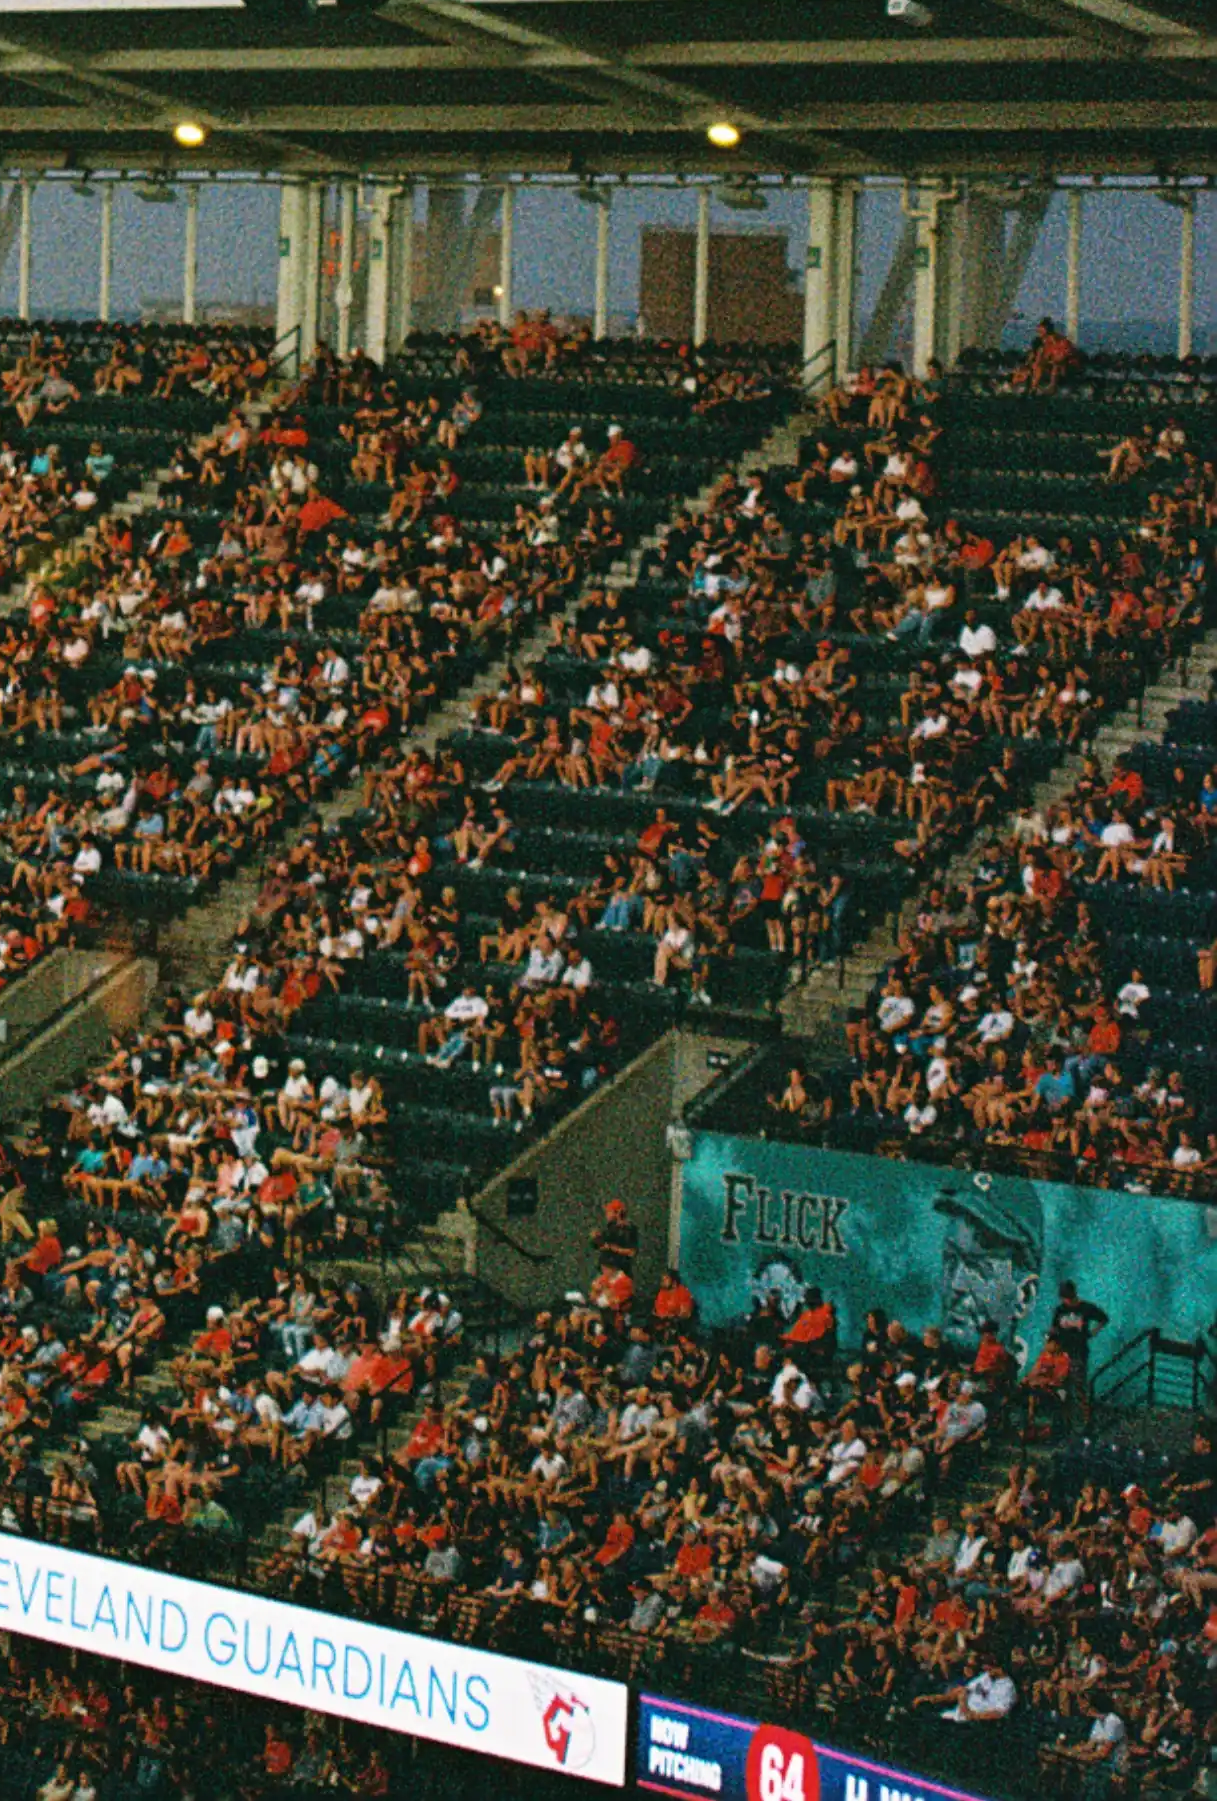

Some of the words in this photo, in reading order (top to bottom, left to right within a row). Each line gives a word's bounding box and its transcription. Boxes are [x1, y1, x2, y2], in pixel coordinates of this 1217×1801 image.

[720, 1172, 850, 1258] FLICK
[202, 1611, 492, 1733] GUARDIANS
[650, 1713, 690, 1751] NOW
[648, 1743, 722, 1792] PITCHING
[759, 1743, 805, 1801] 64
